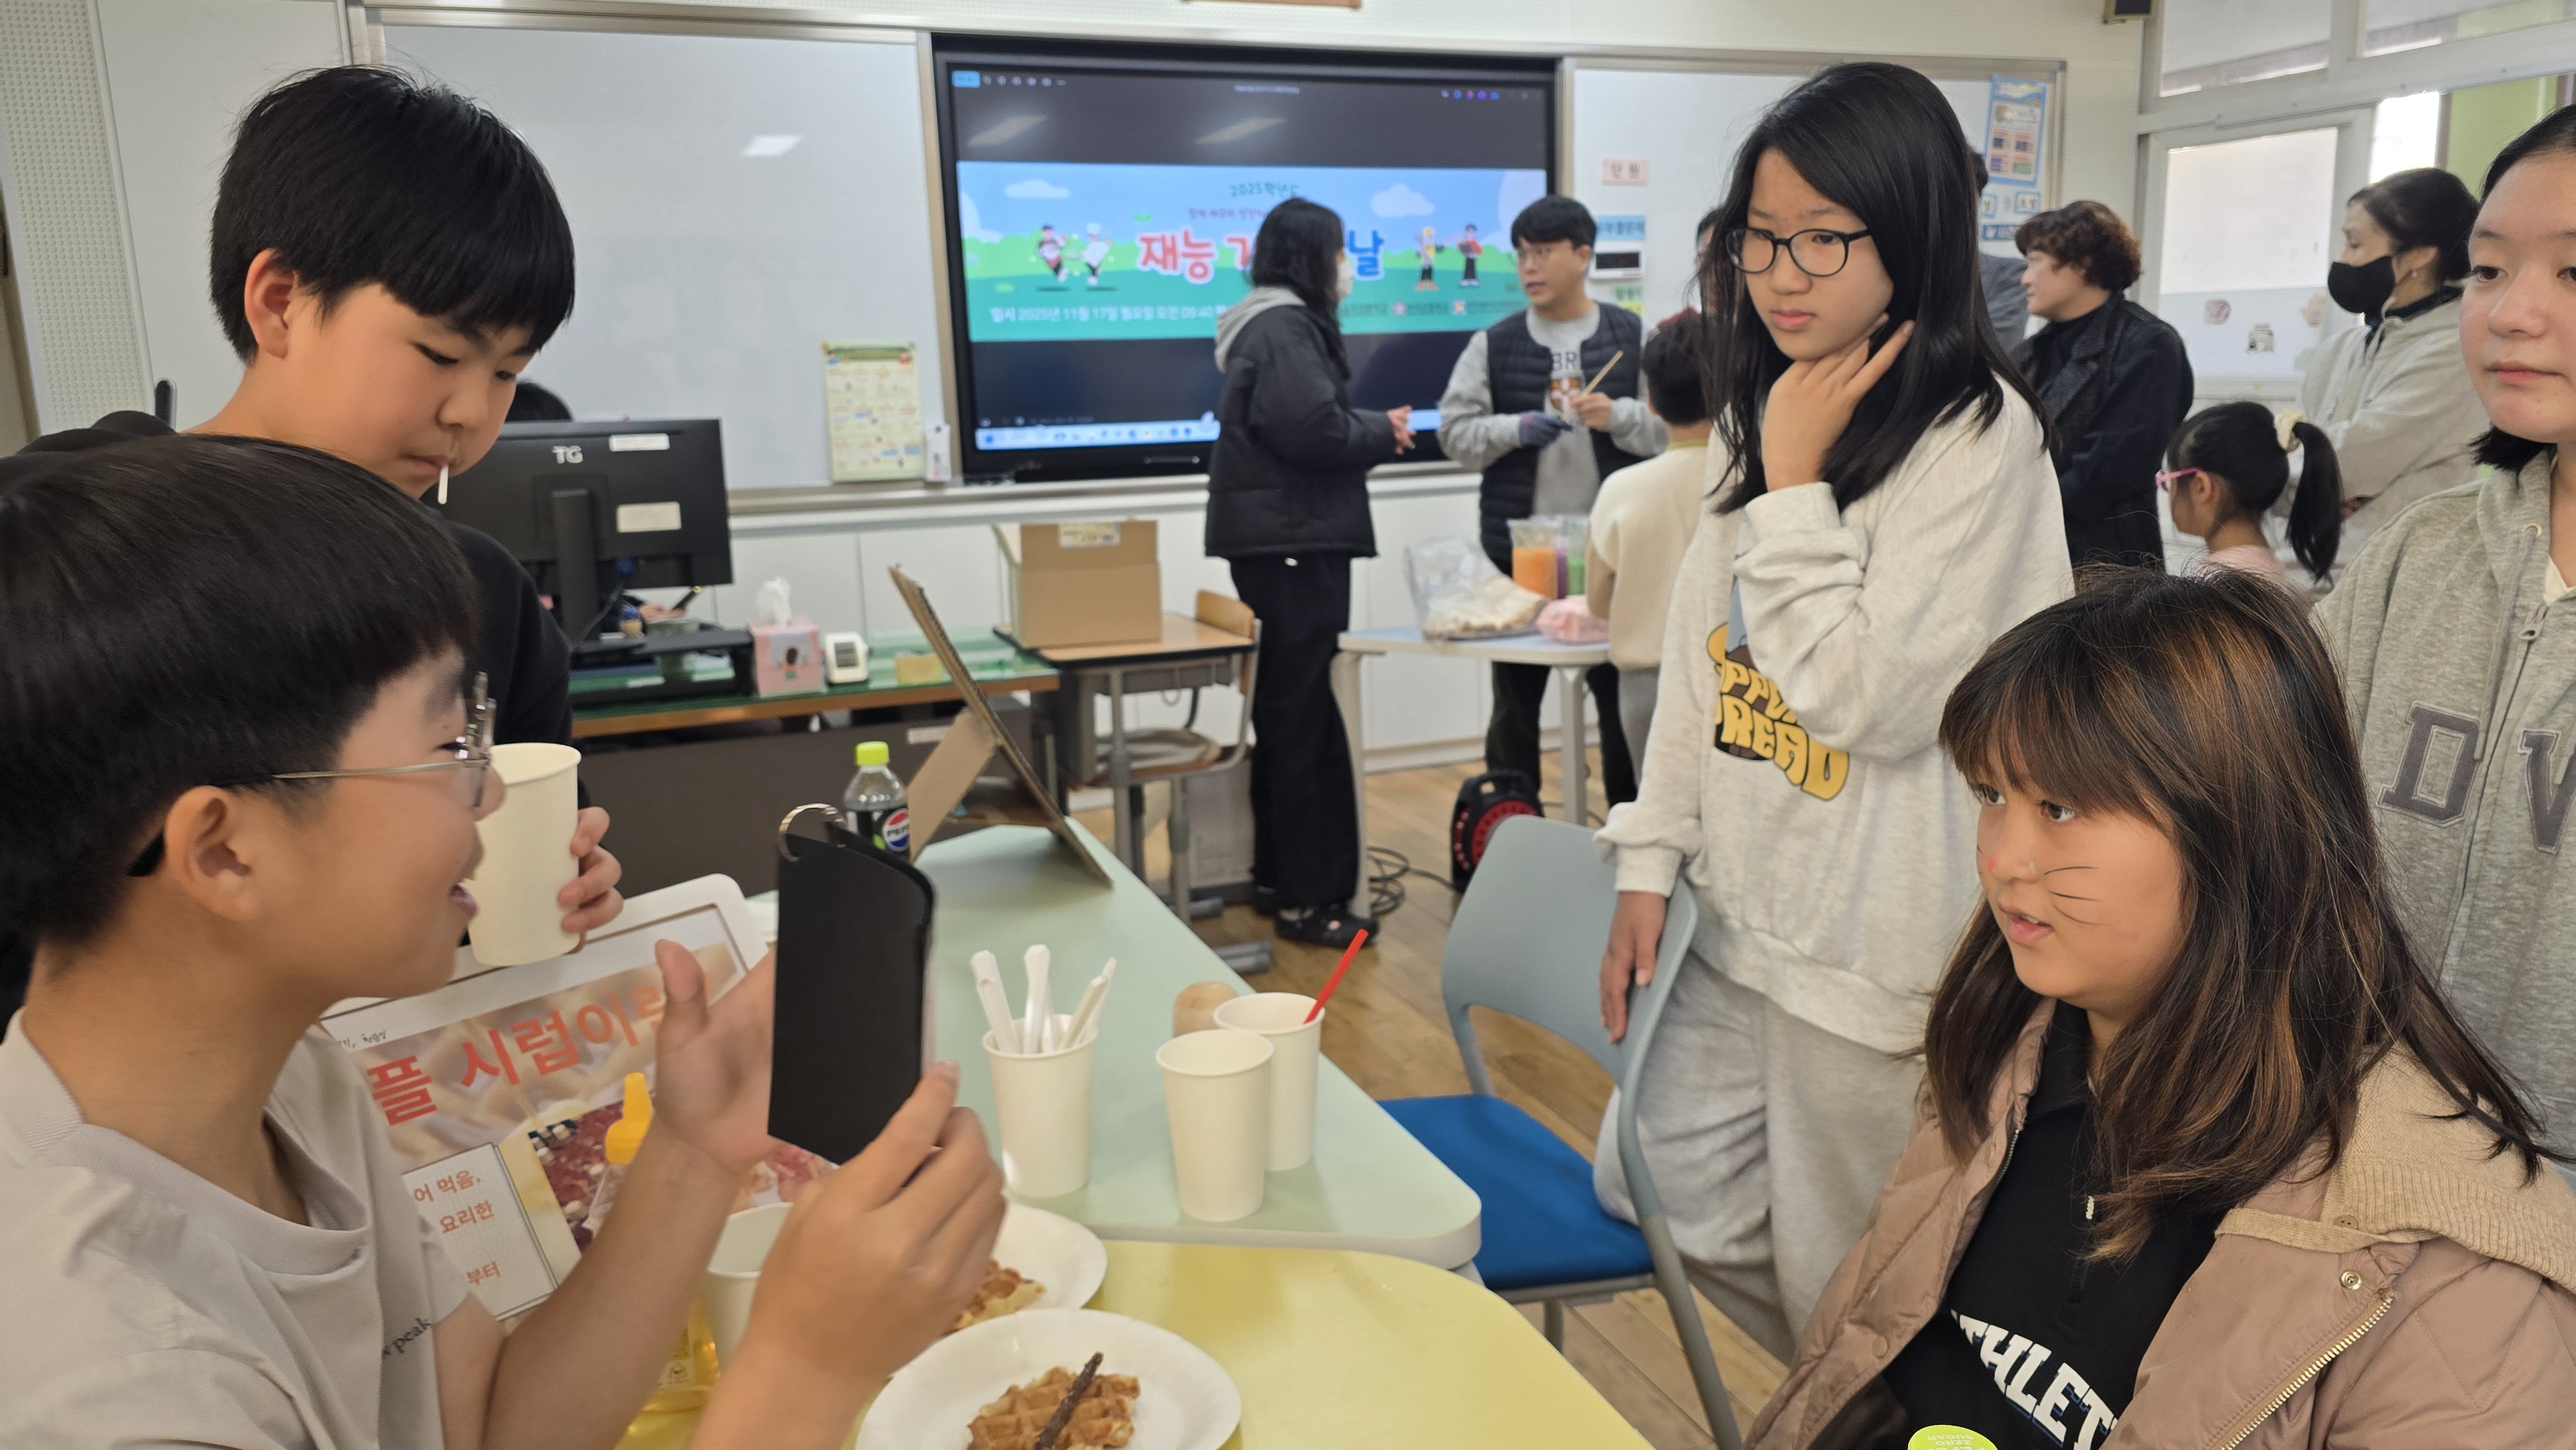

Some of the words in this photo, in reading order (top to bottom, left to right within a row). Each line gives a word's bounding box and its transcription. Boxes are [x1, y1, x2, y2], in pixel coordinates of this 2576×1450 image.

[1137, 229, 1217, 281] 재능
[1347, 228, 1385, 277] 날
[1018, 306, 1061, 323] 2025년
[552, 444, 583, 464] TG
[1716, 693, 1850, 800] READ
[439, 1199, 495, 1234] 요리한
[466, 1261, 501, 1286] 부터
[392, 1317, 432, 1353] peak
[1951, 1308, 2119, 1450] THLET
